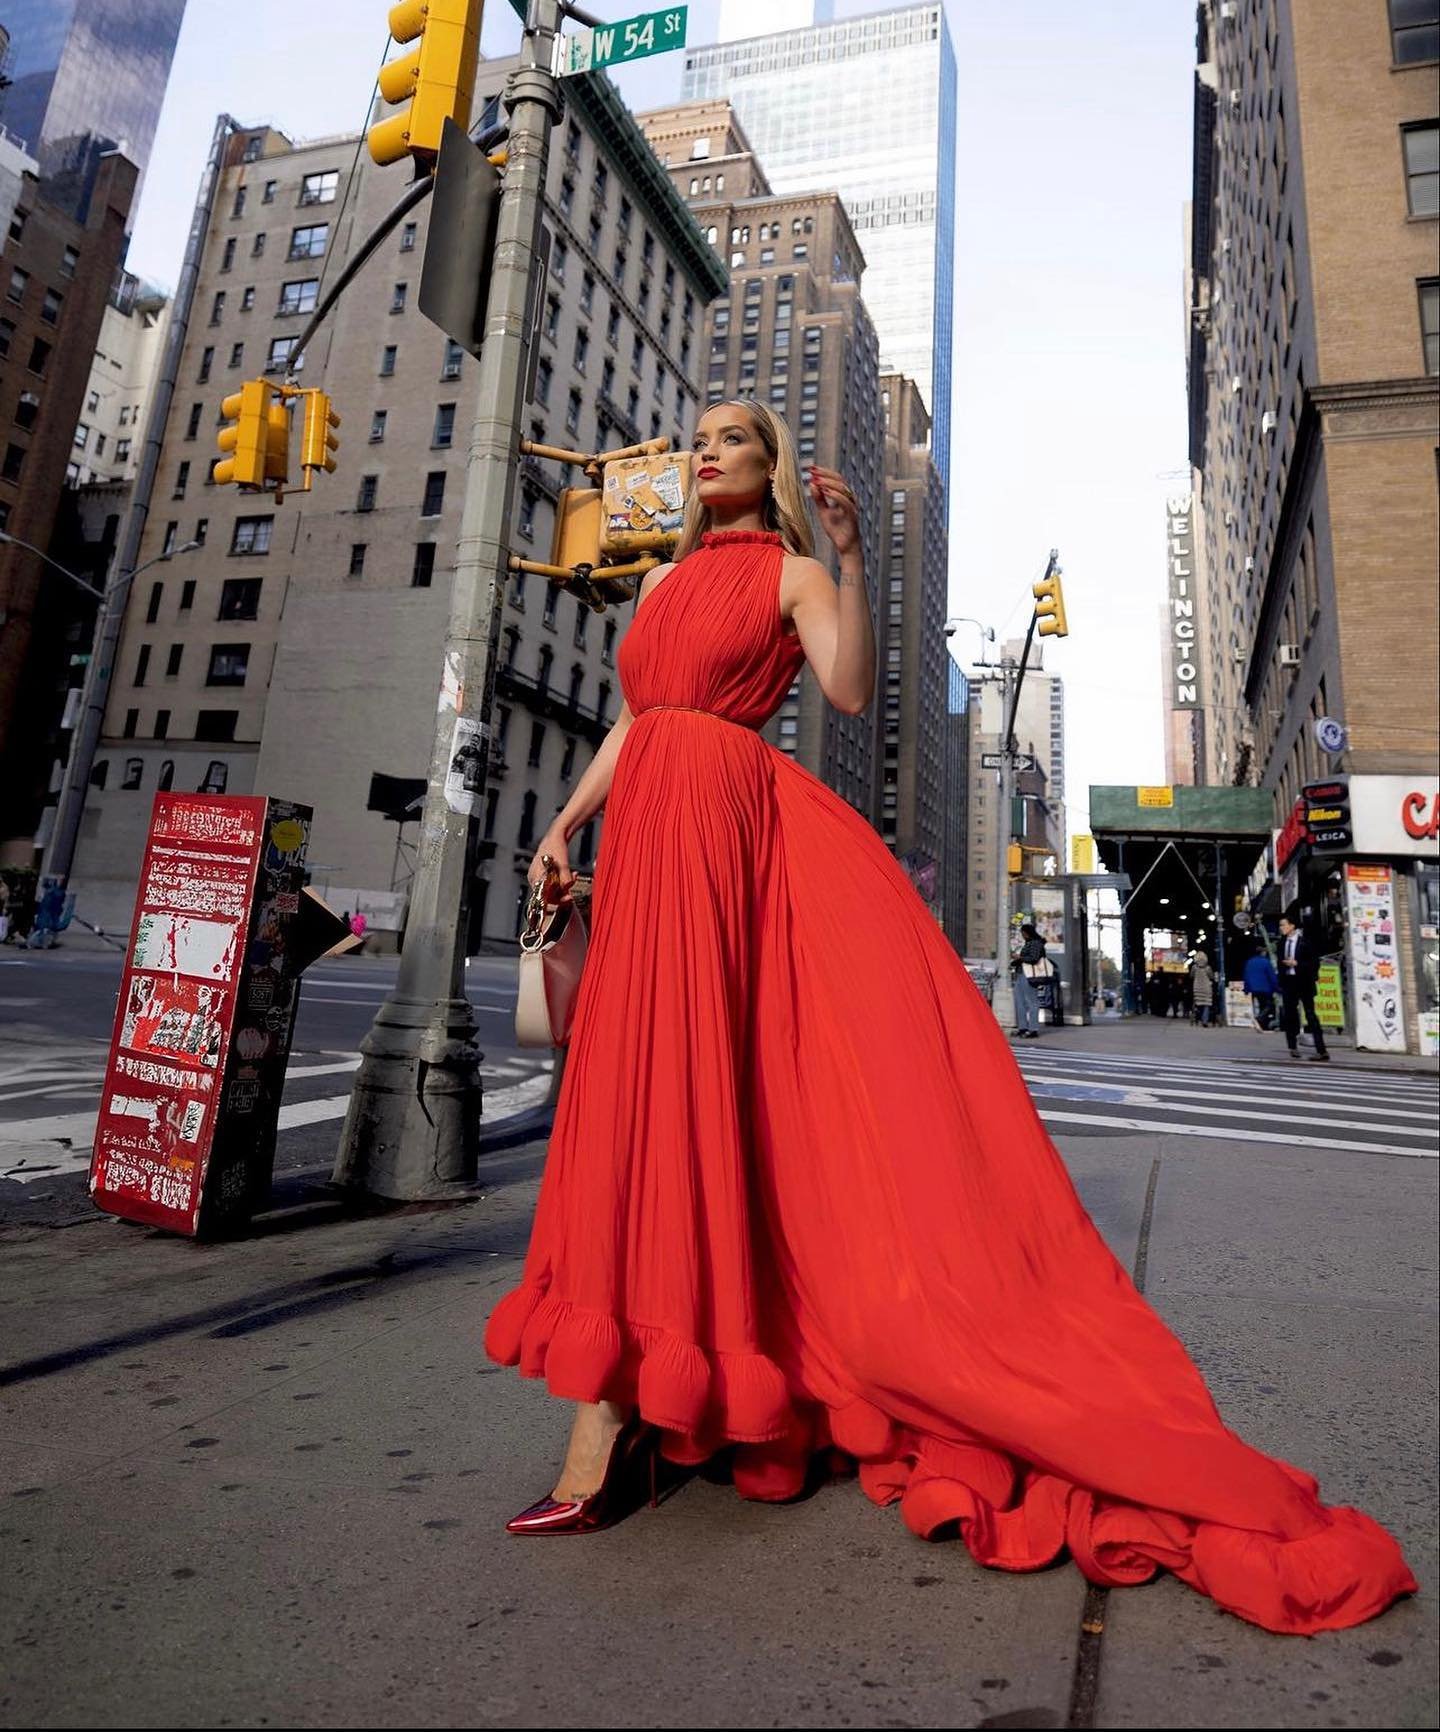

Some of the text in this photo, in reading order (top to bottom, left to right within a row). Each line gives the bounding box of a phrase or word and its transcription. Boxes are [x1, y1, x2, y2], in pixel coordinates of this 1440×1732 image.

[595, 28, 615, 62] W
[624, 19, 655, 56] 54
[664, 14, 680, 34] St
[1167, 497, 1197, 703] WELLINGTON
[1308, 807, 1342, 822] Nikon
[1316, 832, 1346, 842] LEICA
